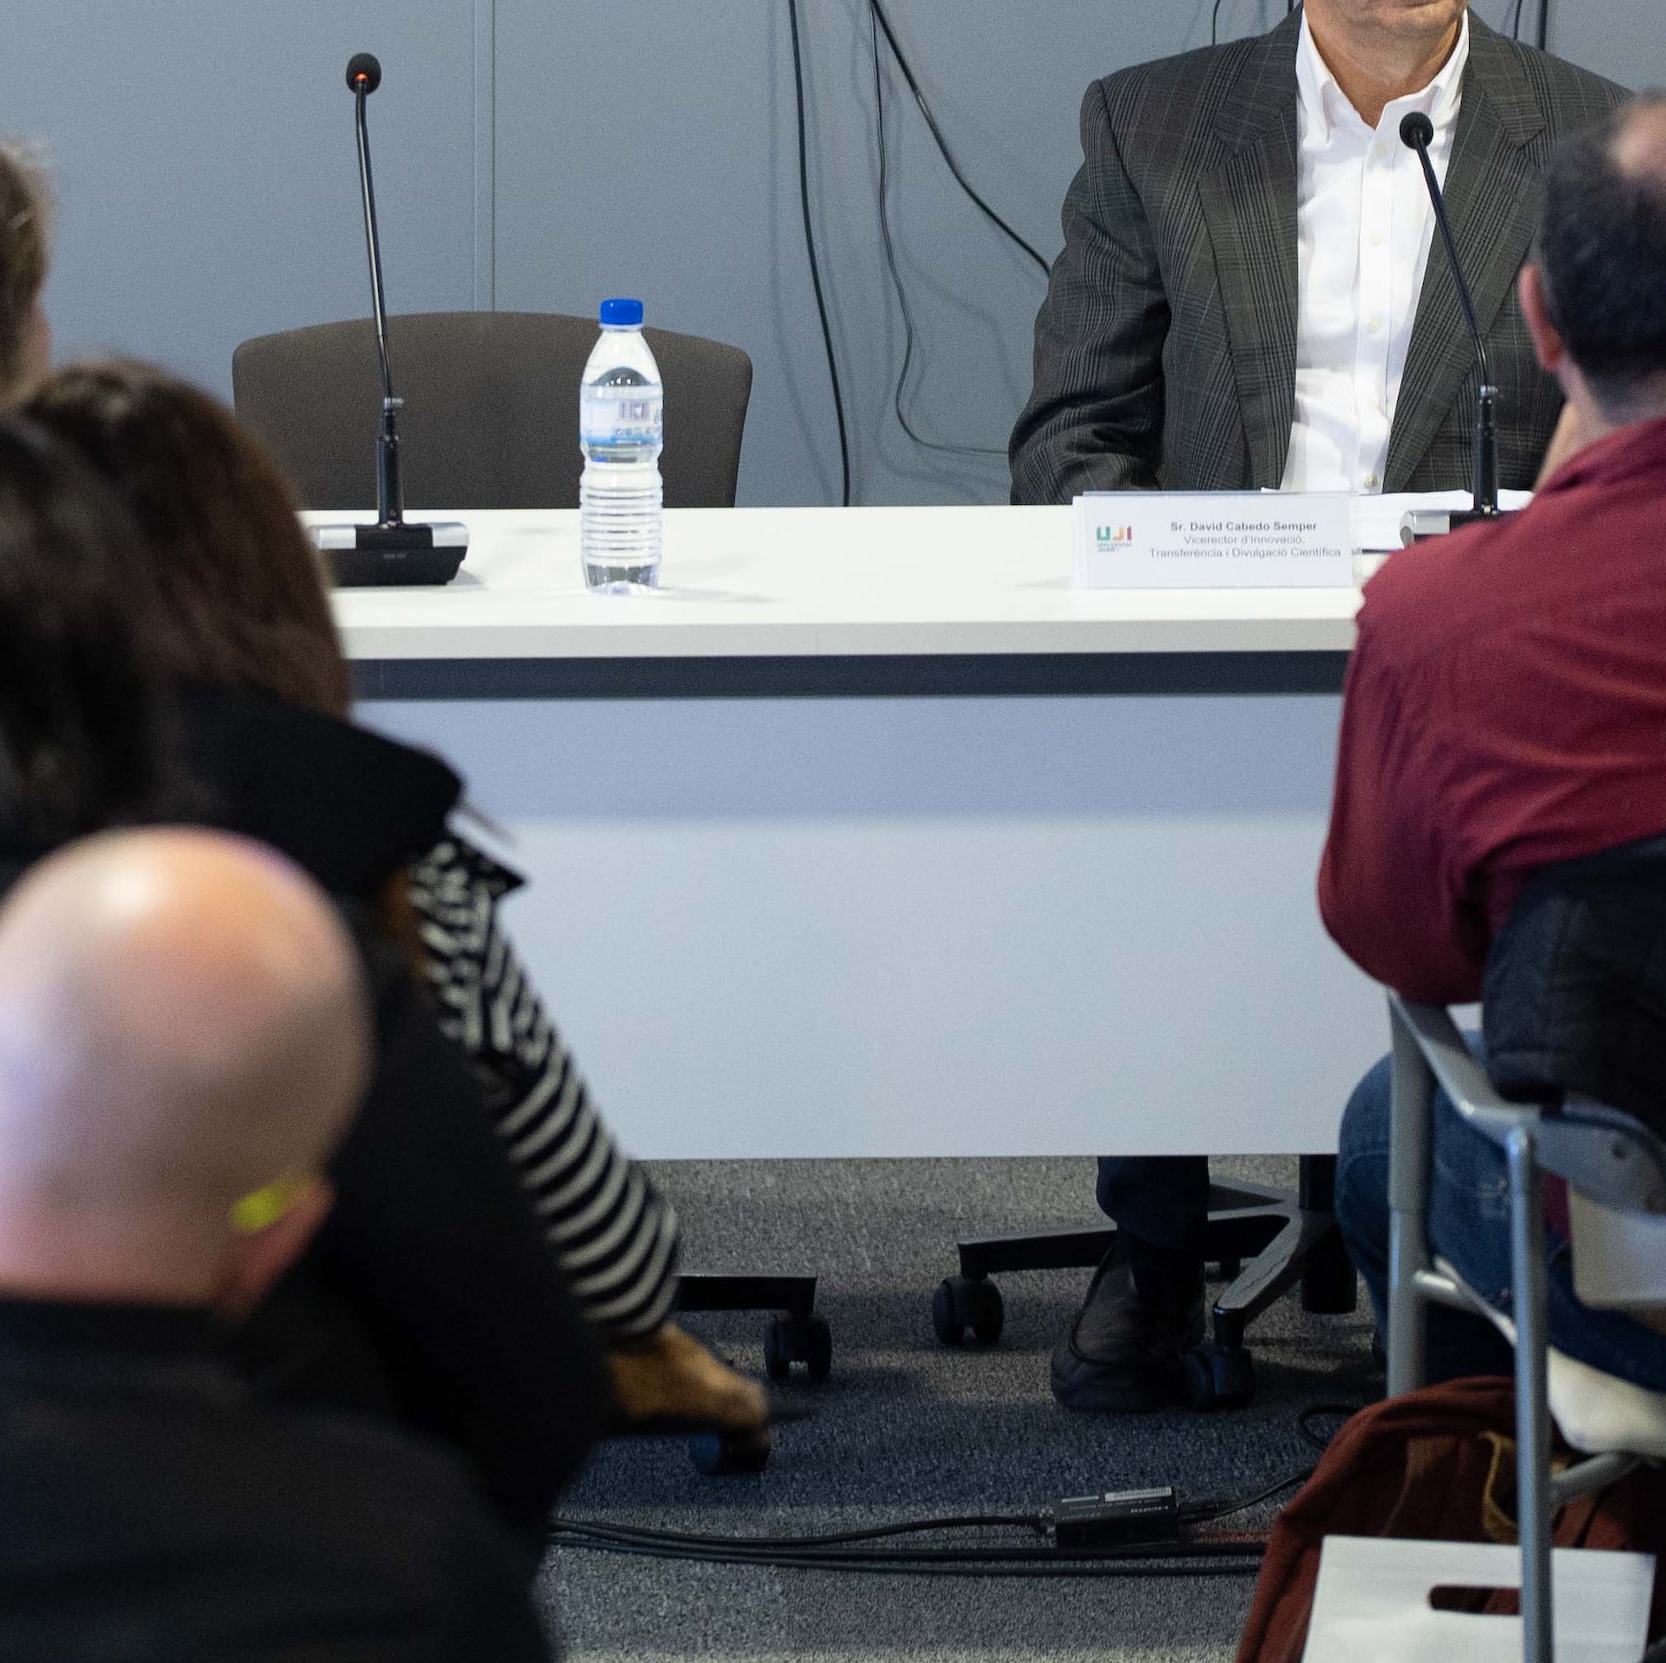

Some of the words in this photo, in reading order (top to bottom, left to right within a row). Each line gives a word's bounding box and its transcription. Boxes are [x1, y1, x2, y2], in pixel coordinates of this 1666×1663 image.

[1190, 521, 1223, 532] David
[1226, 521, 1270, 532] Cabedo
[1273, 521, 1317, 534] Semper
[1183, 534, 1238, 546] Vicerector
[1231, 546, 1288, 560] Divulgació
[1290, 545, 1342, 558] Científica
